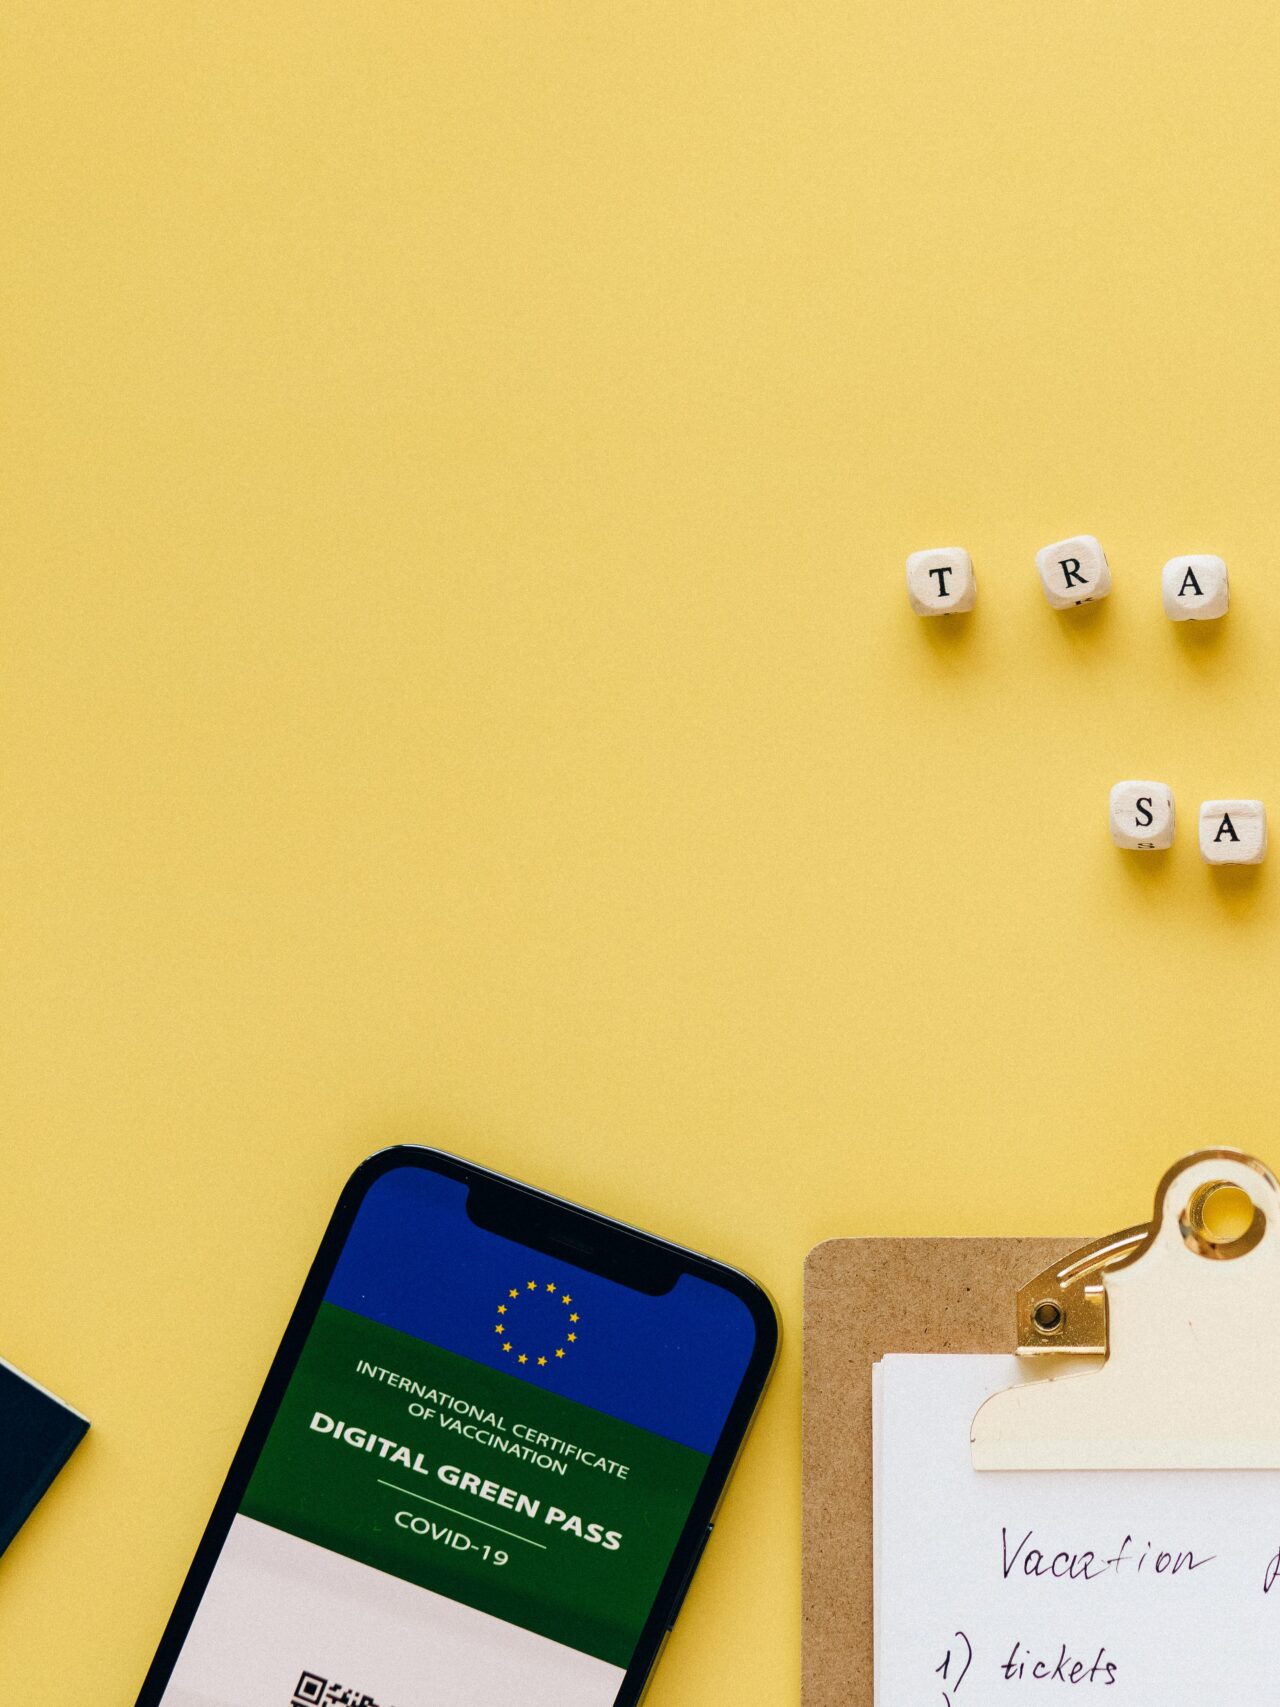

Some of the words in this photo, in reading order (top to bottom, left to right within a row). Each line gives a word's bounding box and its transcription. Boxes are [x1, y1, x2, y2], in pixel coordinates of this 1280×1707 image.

[355, 1359, 507, 1432] INTERNATIONAL
[511, 1423, 631, 1480] CERTIFICATE
[407, 1402, 436, 1421] OF
[438, 1412, 569, 1477] VACCINATION
[308, 1411, 430, 1475] DIGITAL
[436, 1464, 541, 1519] GREEN
[544, 1506, 624, 1551] PASS
[394, 1510, 510, 1567] COVID-19
[1001, 1527, 1217, 1580] Vacation
[935, 1631, 973, 1693] 1)
[1001, 1641, 1118, 1685] tickets
